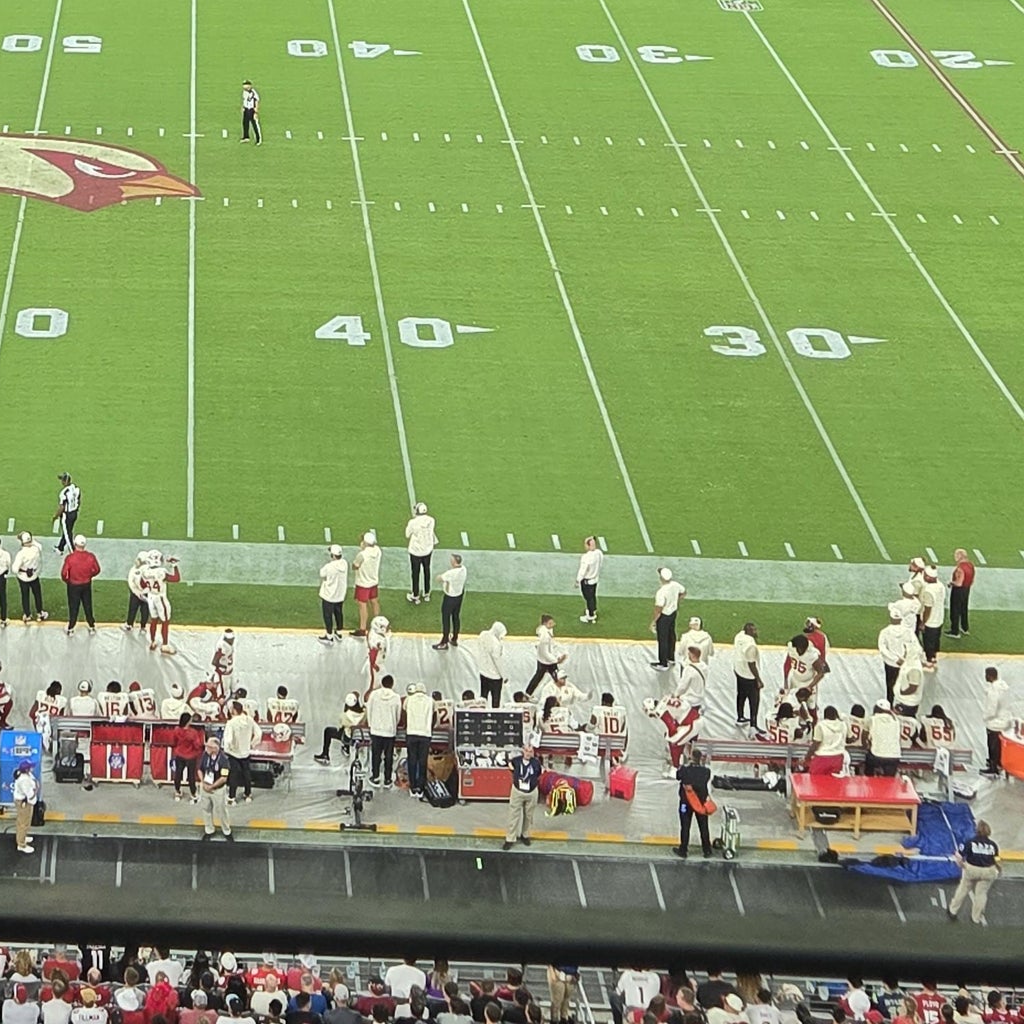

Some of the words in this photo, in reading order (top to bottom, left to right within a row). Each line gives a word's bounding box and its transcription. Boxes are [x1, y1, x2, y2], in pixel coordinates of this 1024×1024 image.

[106, 701, 121, 718] 16
[138, 697, 155, 714] 13
[603, 716, 619, 734] 10
[90, 950, 104, 970] 11
[638, 986, 645, 1004] 1
